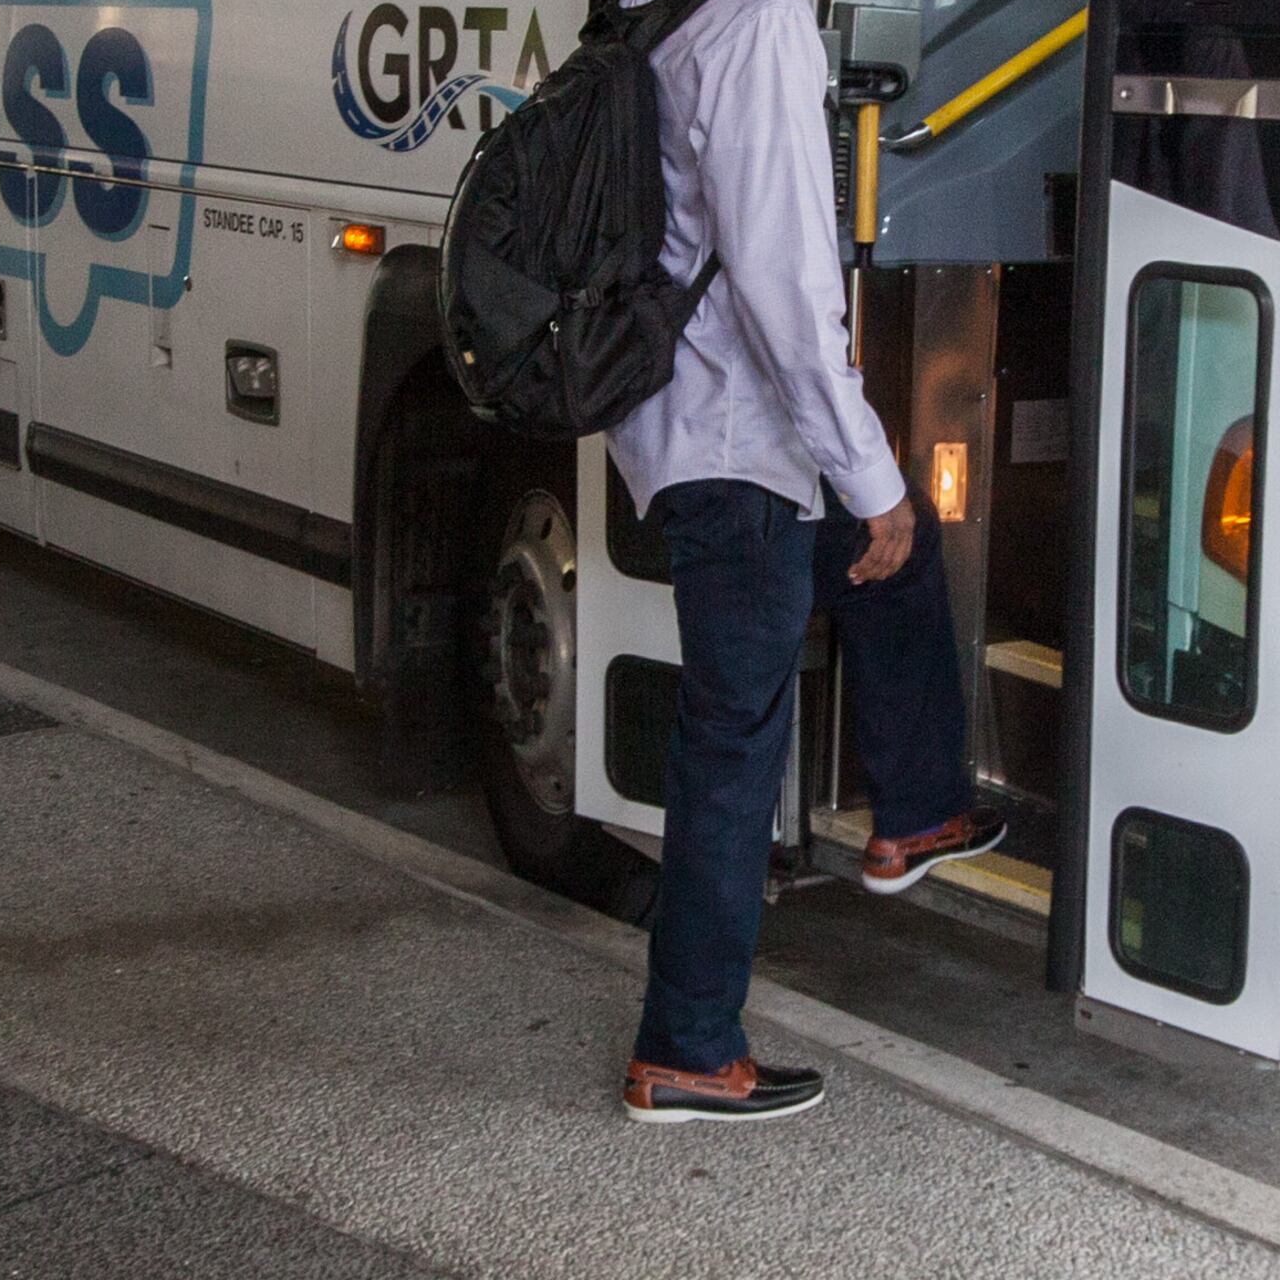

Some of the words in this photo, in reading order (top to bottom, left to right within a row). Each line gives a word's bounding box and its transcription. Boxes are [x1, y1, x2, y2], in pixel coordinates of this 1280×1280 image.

[203, 207, 255, 235] STANDEE
[259, 216, 287, 240] CAP.
[290, 221, 304, 244] 15
